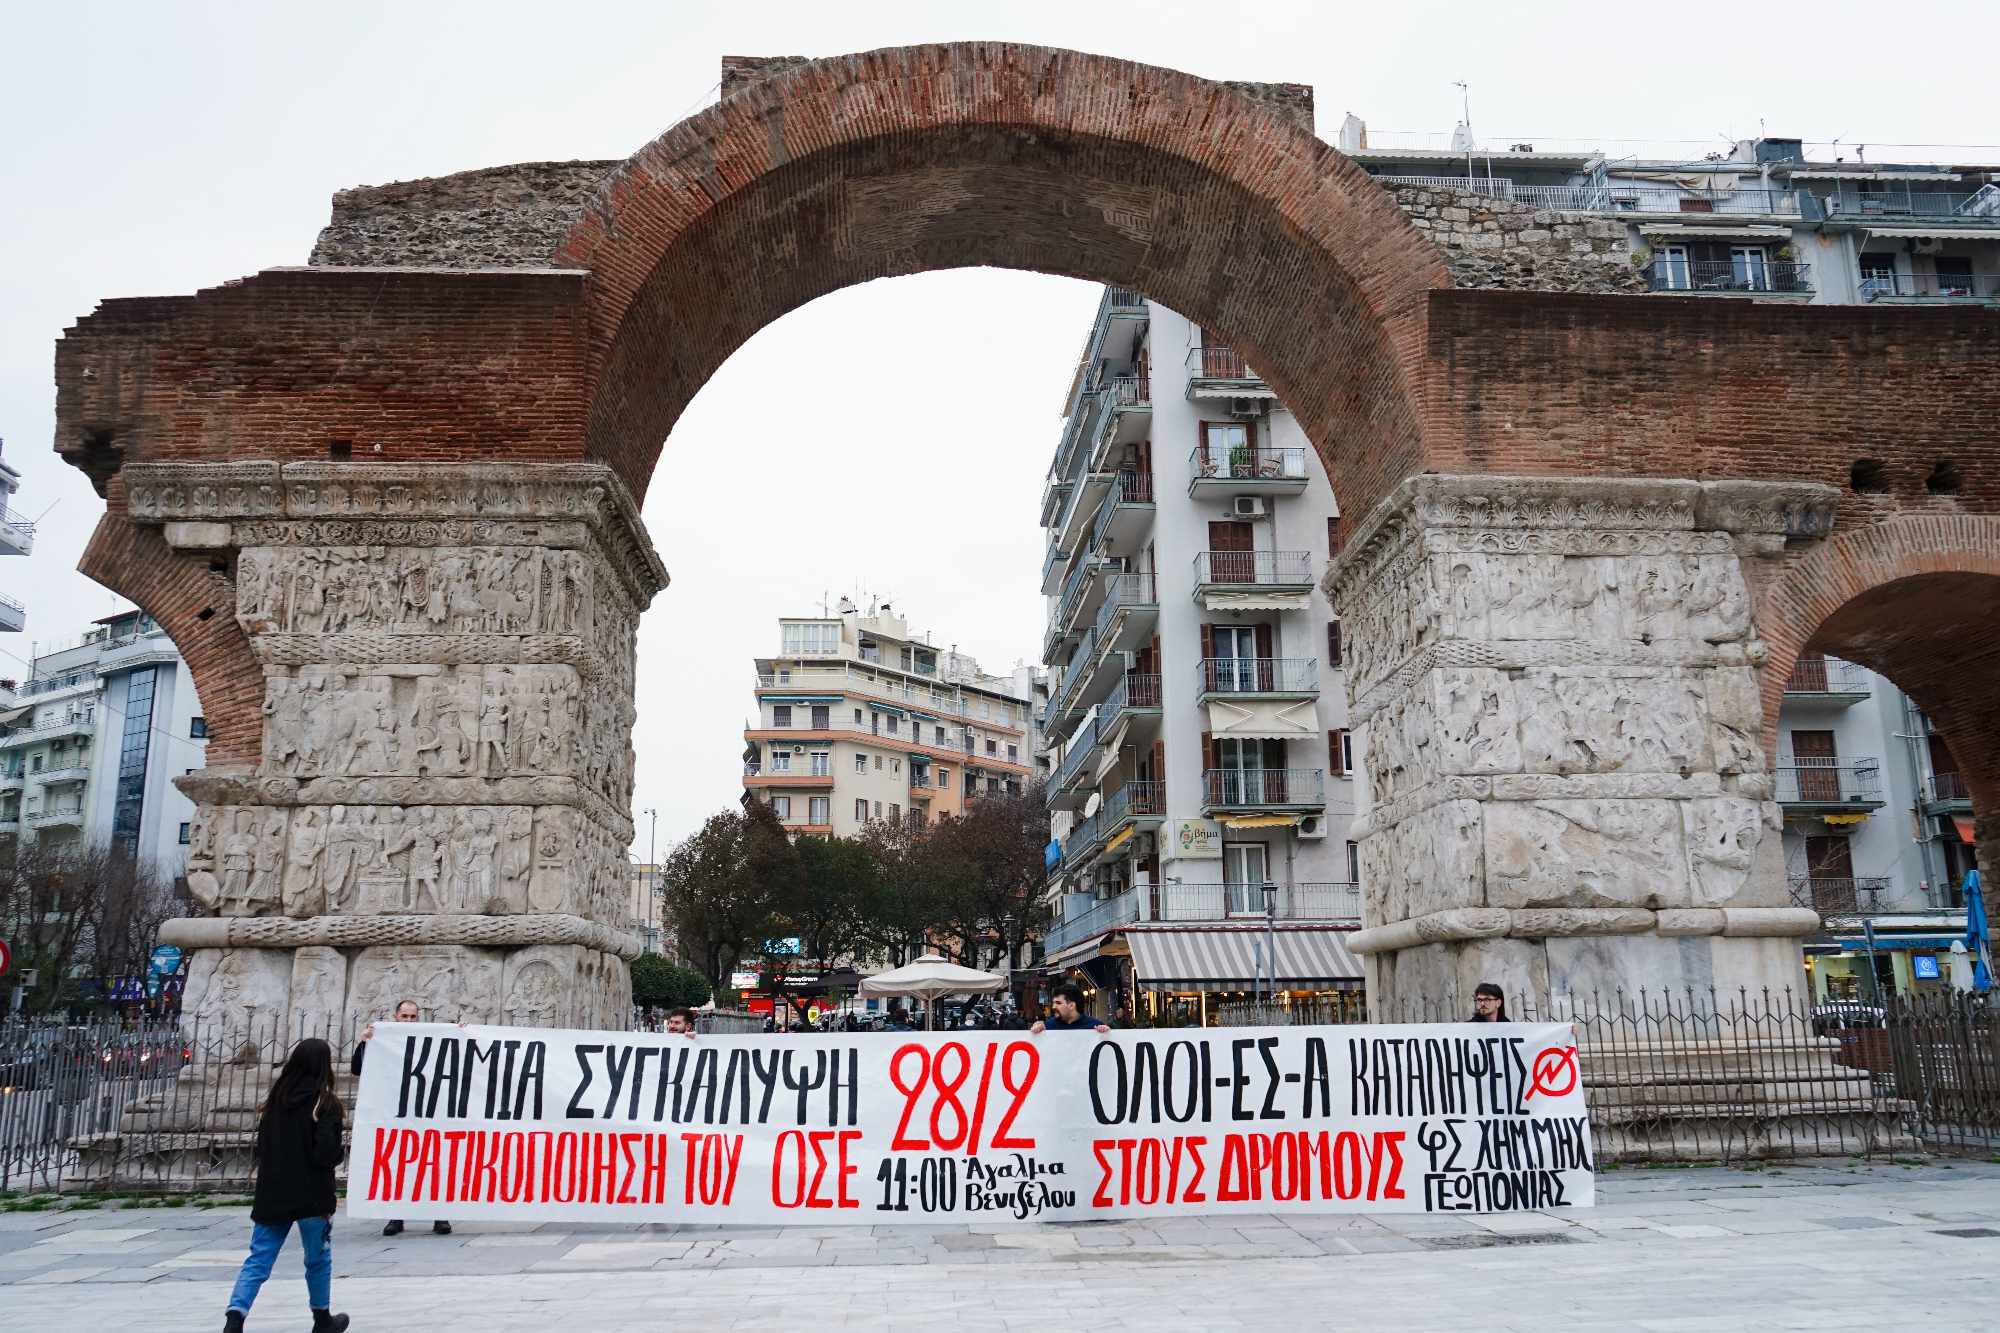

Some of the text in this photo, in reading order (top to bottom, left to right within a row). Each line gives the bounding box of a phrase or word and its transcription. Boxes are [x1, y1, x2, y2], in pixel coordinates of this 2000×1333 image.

[396, 1036, 858, 1127] ΚΑΜΙΑ ΣΥΓΚΑΛΥΨΗ
[889, 1040, 1040, 1156] 28/2
[1349, 1037, 1531, 1117] ΚΑΤΑΛΗΨΕΙΣ
[367, 1127, 863, 1209] ΚΡΑΤΙΚΟΠΟΙΗΣΗ ΤΟΥ ΟΣΕ
[876, 1157, 957, 1213] 11:00
[962, 1153, 1066, 1190] Άγαλμα
[965, 1181, 1076, 1220] Βενιζέλου
[1092, 1130, 1406, 1208] ΣΤΟΥΣ ΔΡΟΜΟΥΣ
[1424, 1169, 1572, 1212] ΓΕΩΠΟΝΙΑΣ
